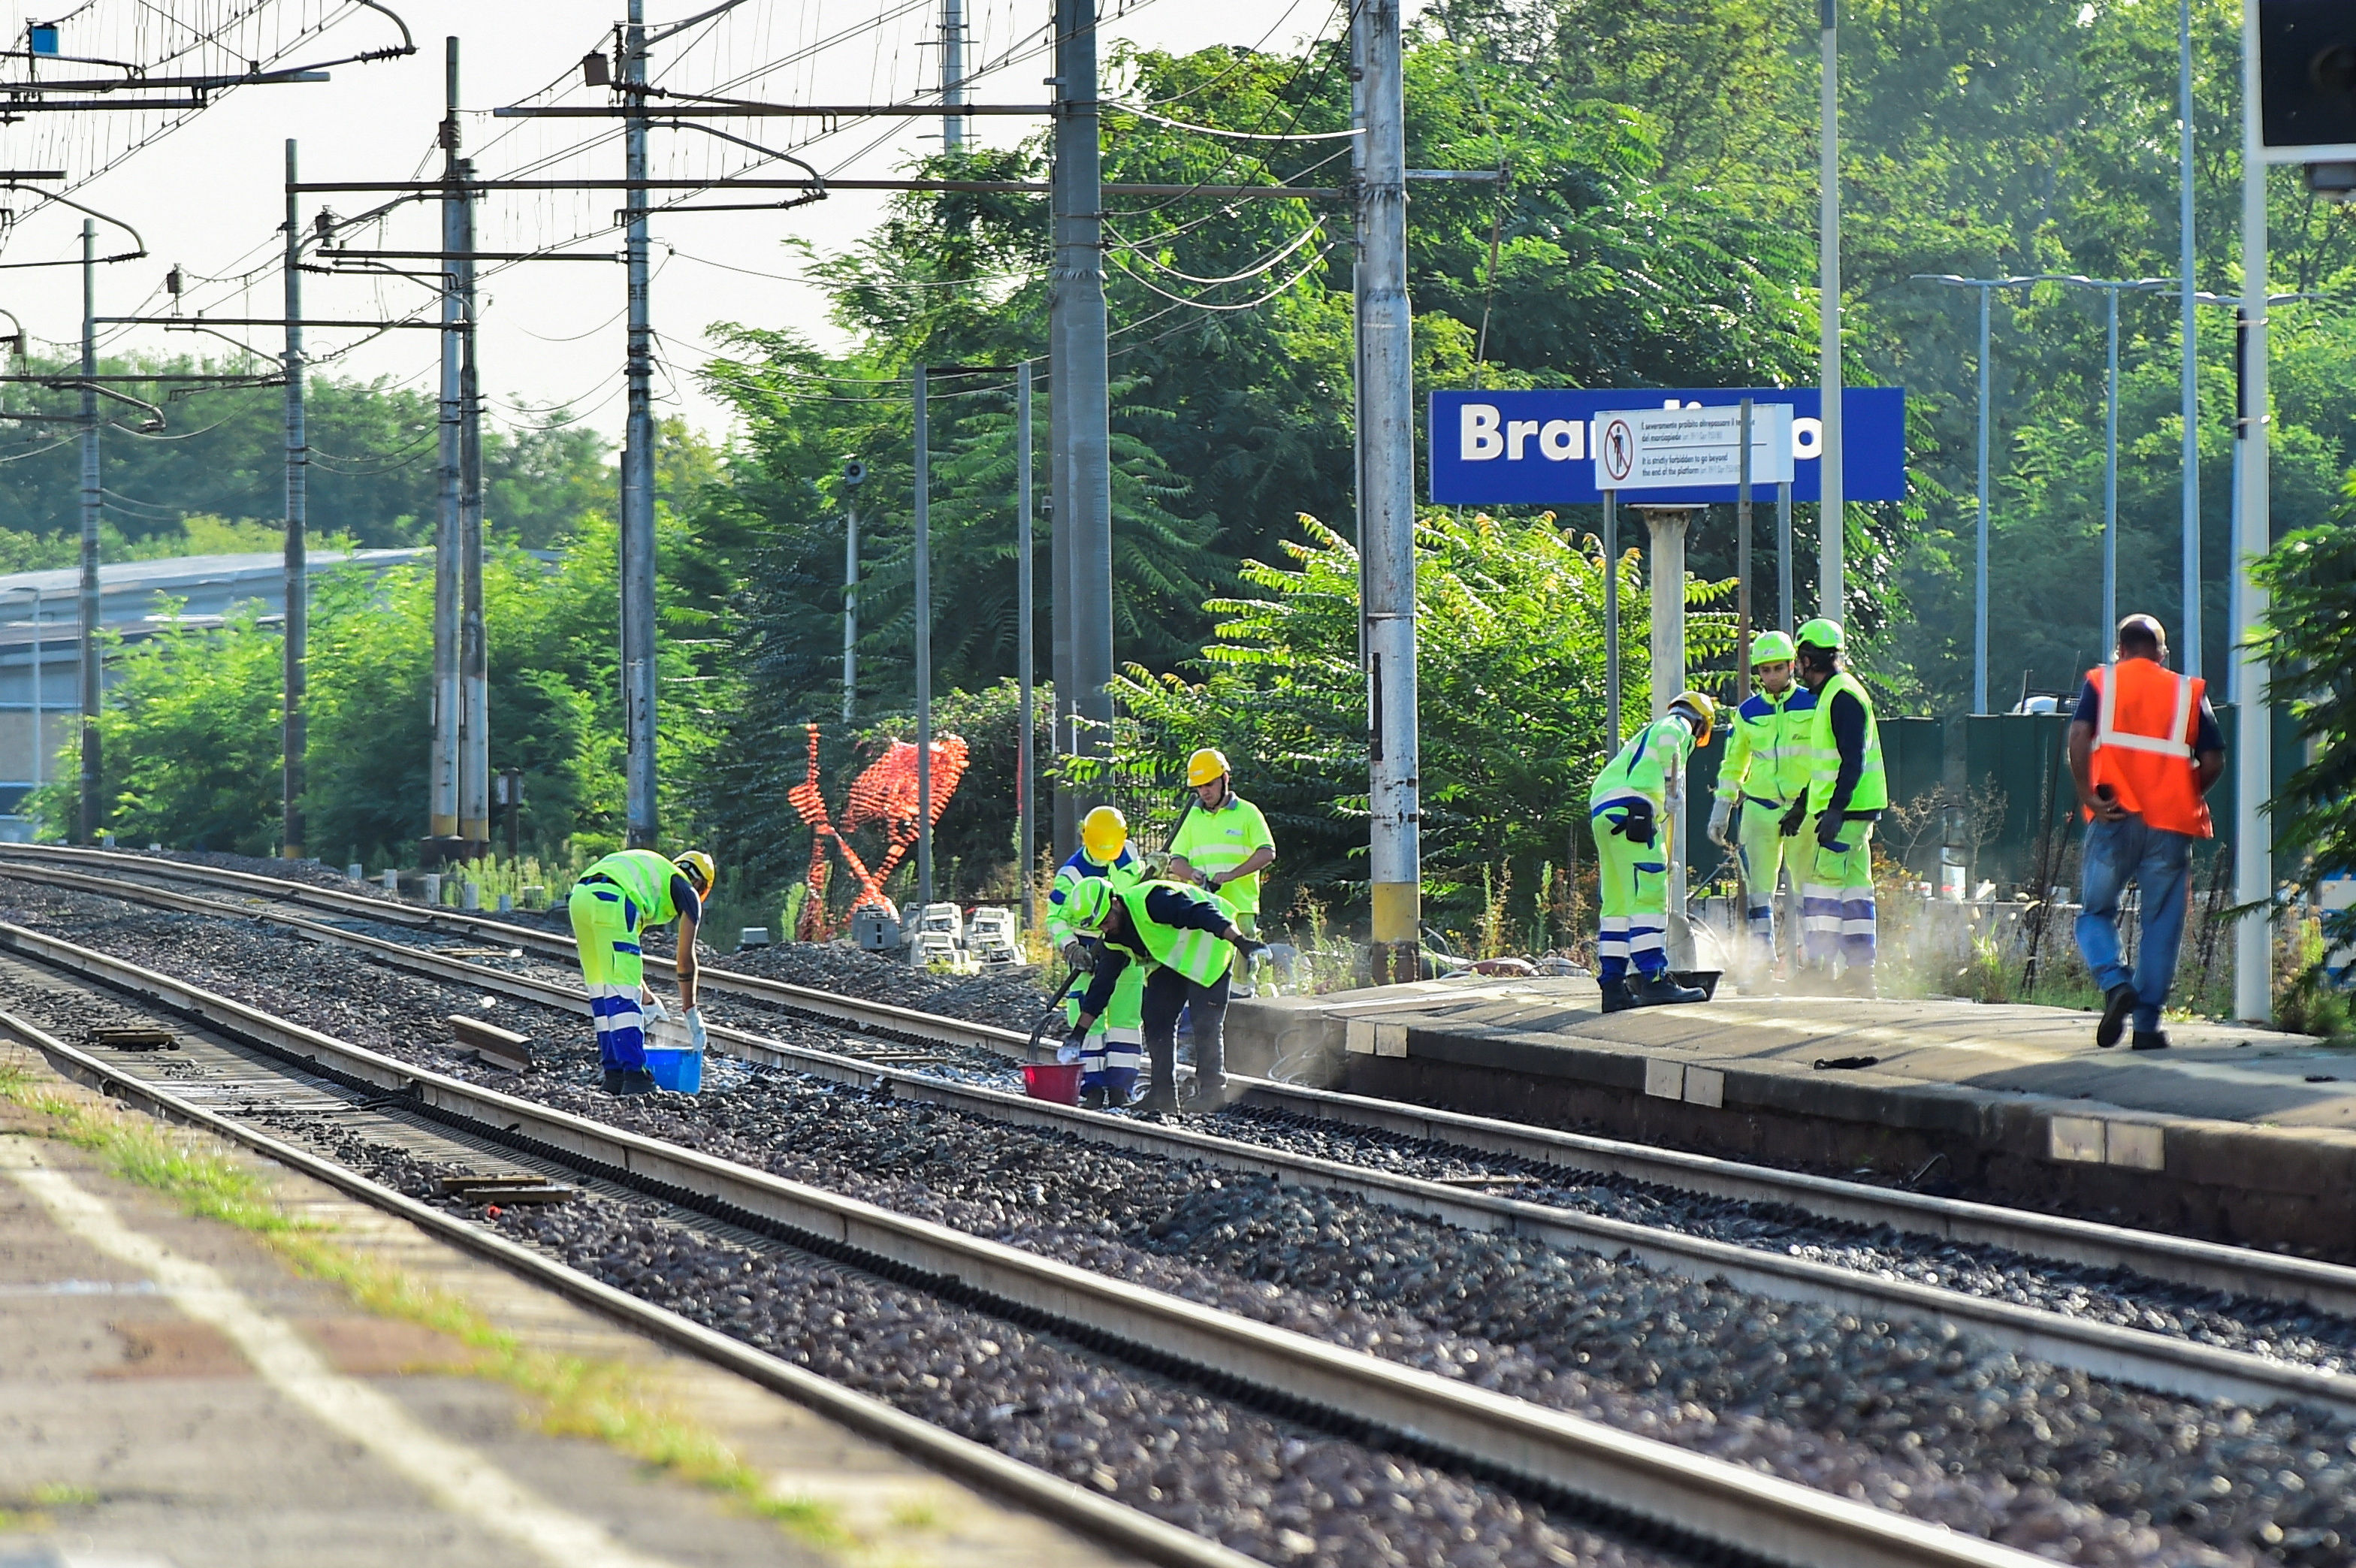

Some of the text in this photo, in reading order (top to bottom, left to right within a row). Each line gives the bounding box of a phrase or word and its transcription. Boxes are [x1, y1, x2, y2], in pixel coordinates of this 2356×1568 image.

[1678, 419, 1698, 430] proibito
[1652, 455, 1668, 467] strictly
[1669, 454, 1694, 464] forbidden
[1695, 455, 1700, 463] to
[1701, 455, 1708, 464] go
[1708, 452, 1728, 464] beyond
[1642, 467, 1651, 476] the
[1651, 467, 1661, 476] end
[1668, 467, 1676, 476] the
[1677, 464, 1699, 477] platform
